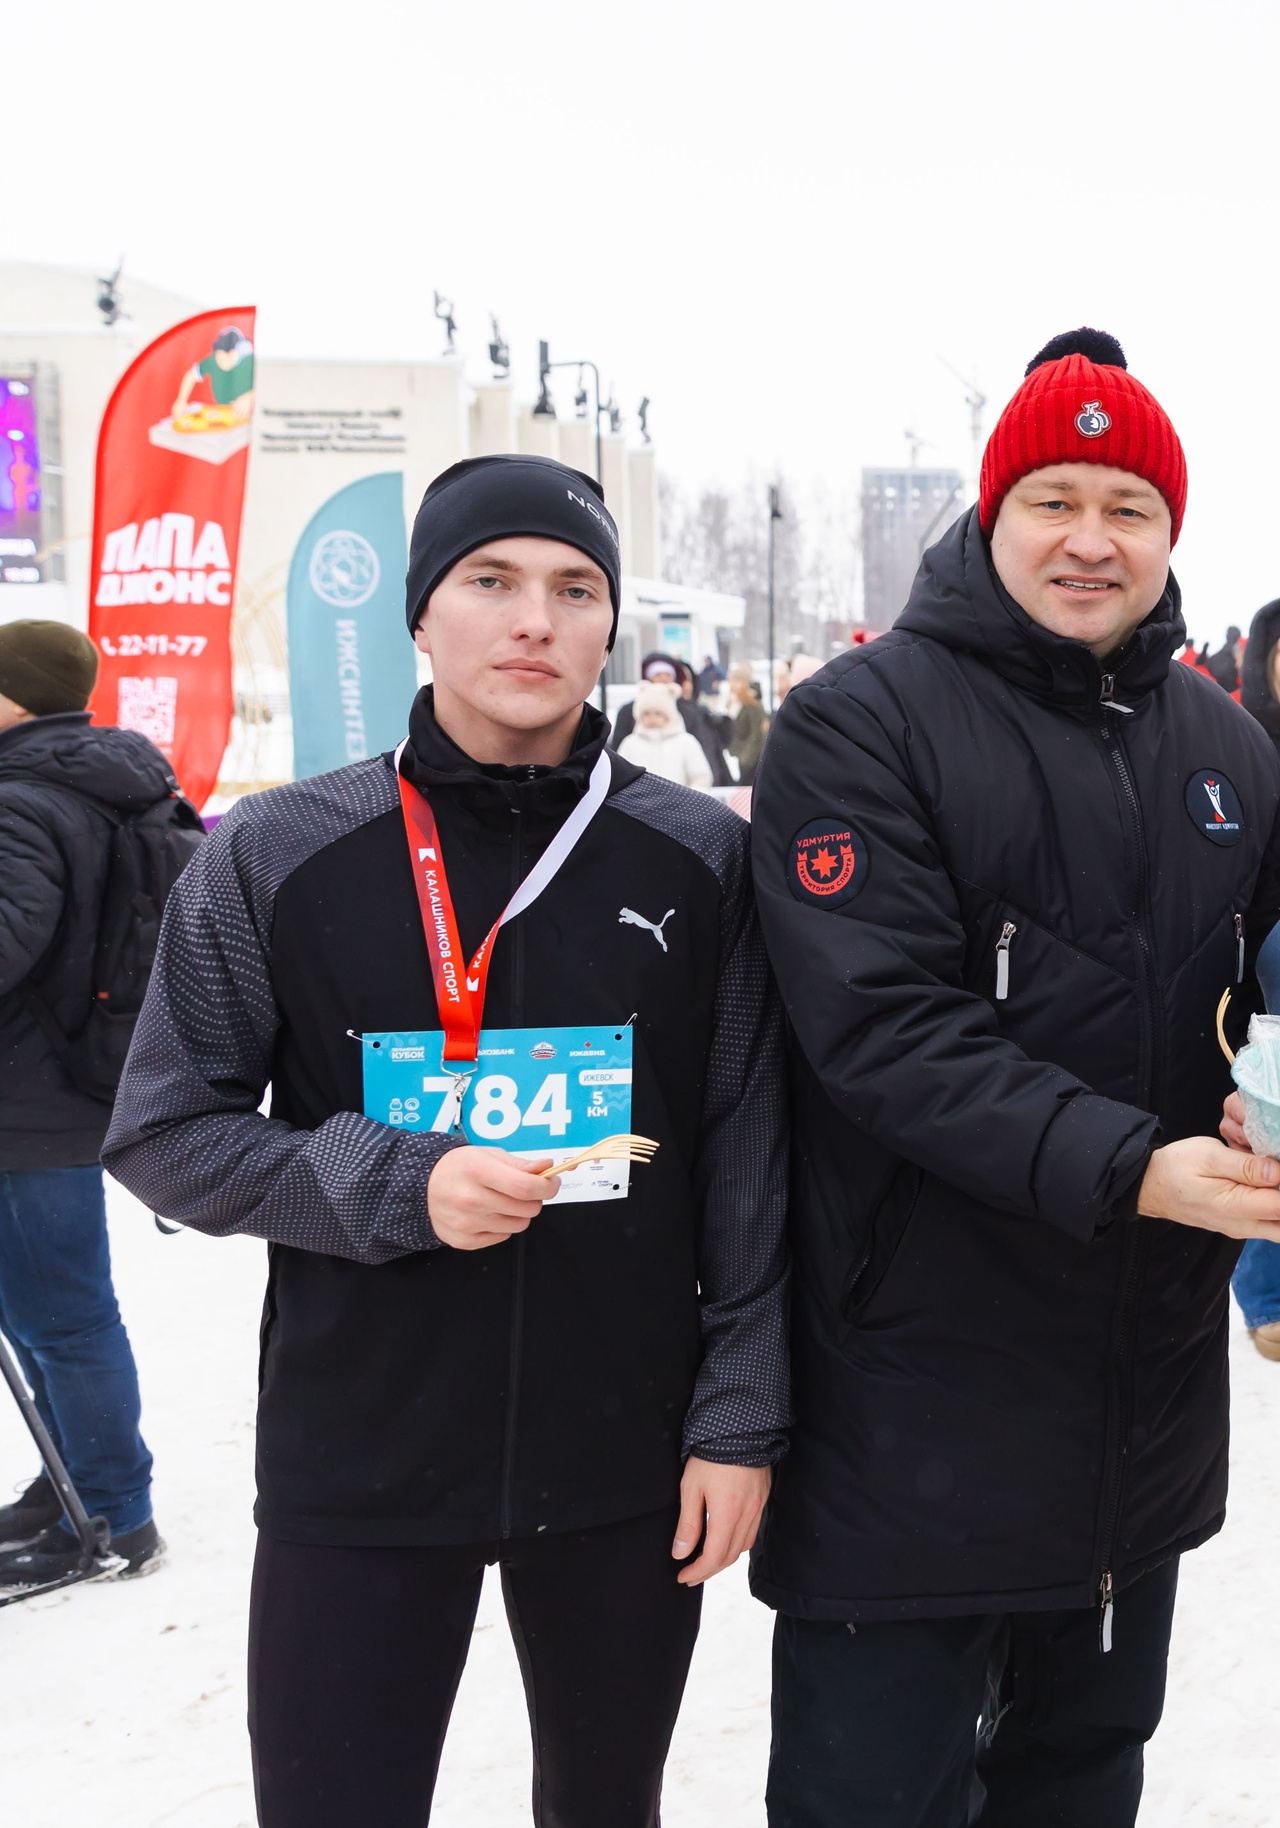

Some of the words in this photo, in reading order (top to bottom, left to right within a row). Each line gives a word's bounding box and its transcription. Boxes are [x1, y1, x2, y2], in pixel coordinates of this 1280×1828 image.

[101, 512, 231, 572] ПАПА
[95, 569, 232, 607] ДЖОНС
[118, 634, 207, 657] 22-11-77
[797, 832, 851, 848] УДМУРТИЯ
[799, 865, 836, 892] ТЕРРИТОРИЯ
[836, 857, 852, 886] СПОРТА
[425, 870, 451, 958] КАЛАШНИКОВ
[442, 962, 460, 1002] СПОРТ
[392, 1051, 425, 1060] КУБОК
[583, 1073, 614, 1082] ИЖЕВСК
[422, 1073, 572, 1140] 784
[592, 1091, 604, 1105] 5
[587, 1106, 608, 1117] КМ
